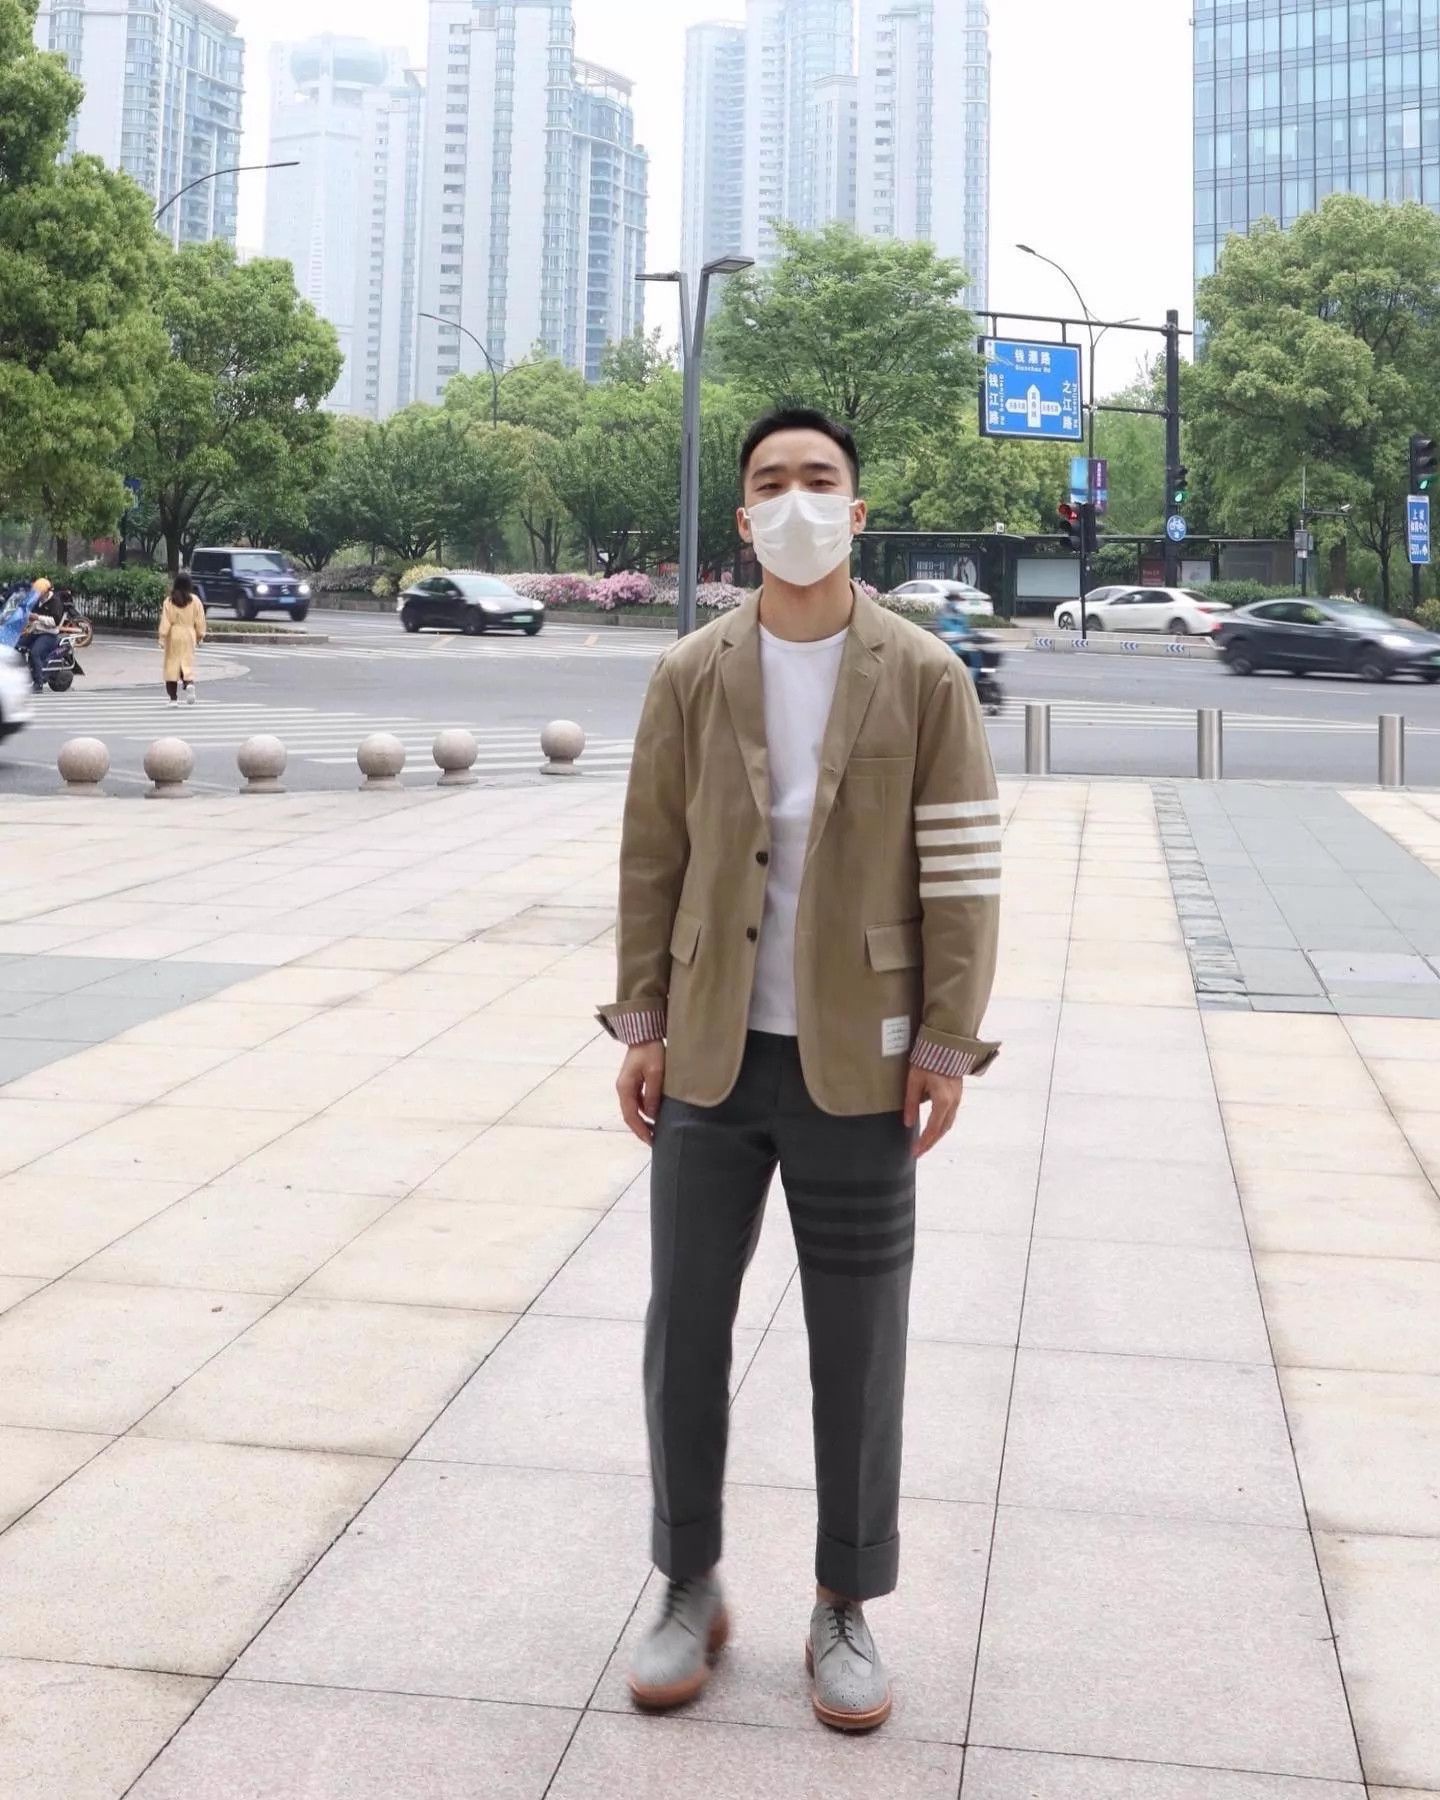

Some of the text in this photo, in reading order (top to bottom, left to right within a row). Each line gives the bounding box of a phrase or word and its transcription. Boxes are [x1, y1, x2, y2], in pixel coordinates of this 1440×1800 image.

[989, 373, 999, 425] 钱江路
[1062, 380, 1072, 430] 之江路
